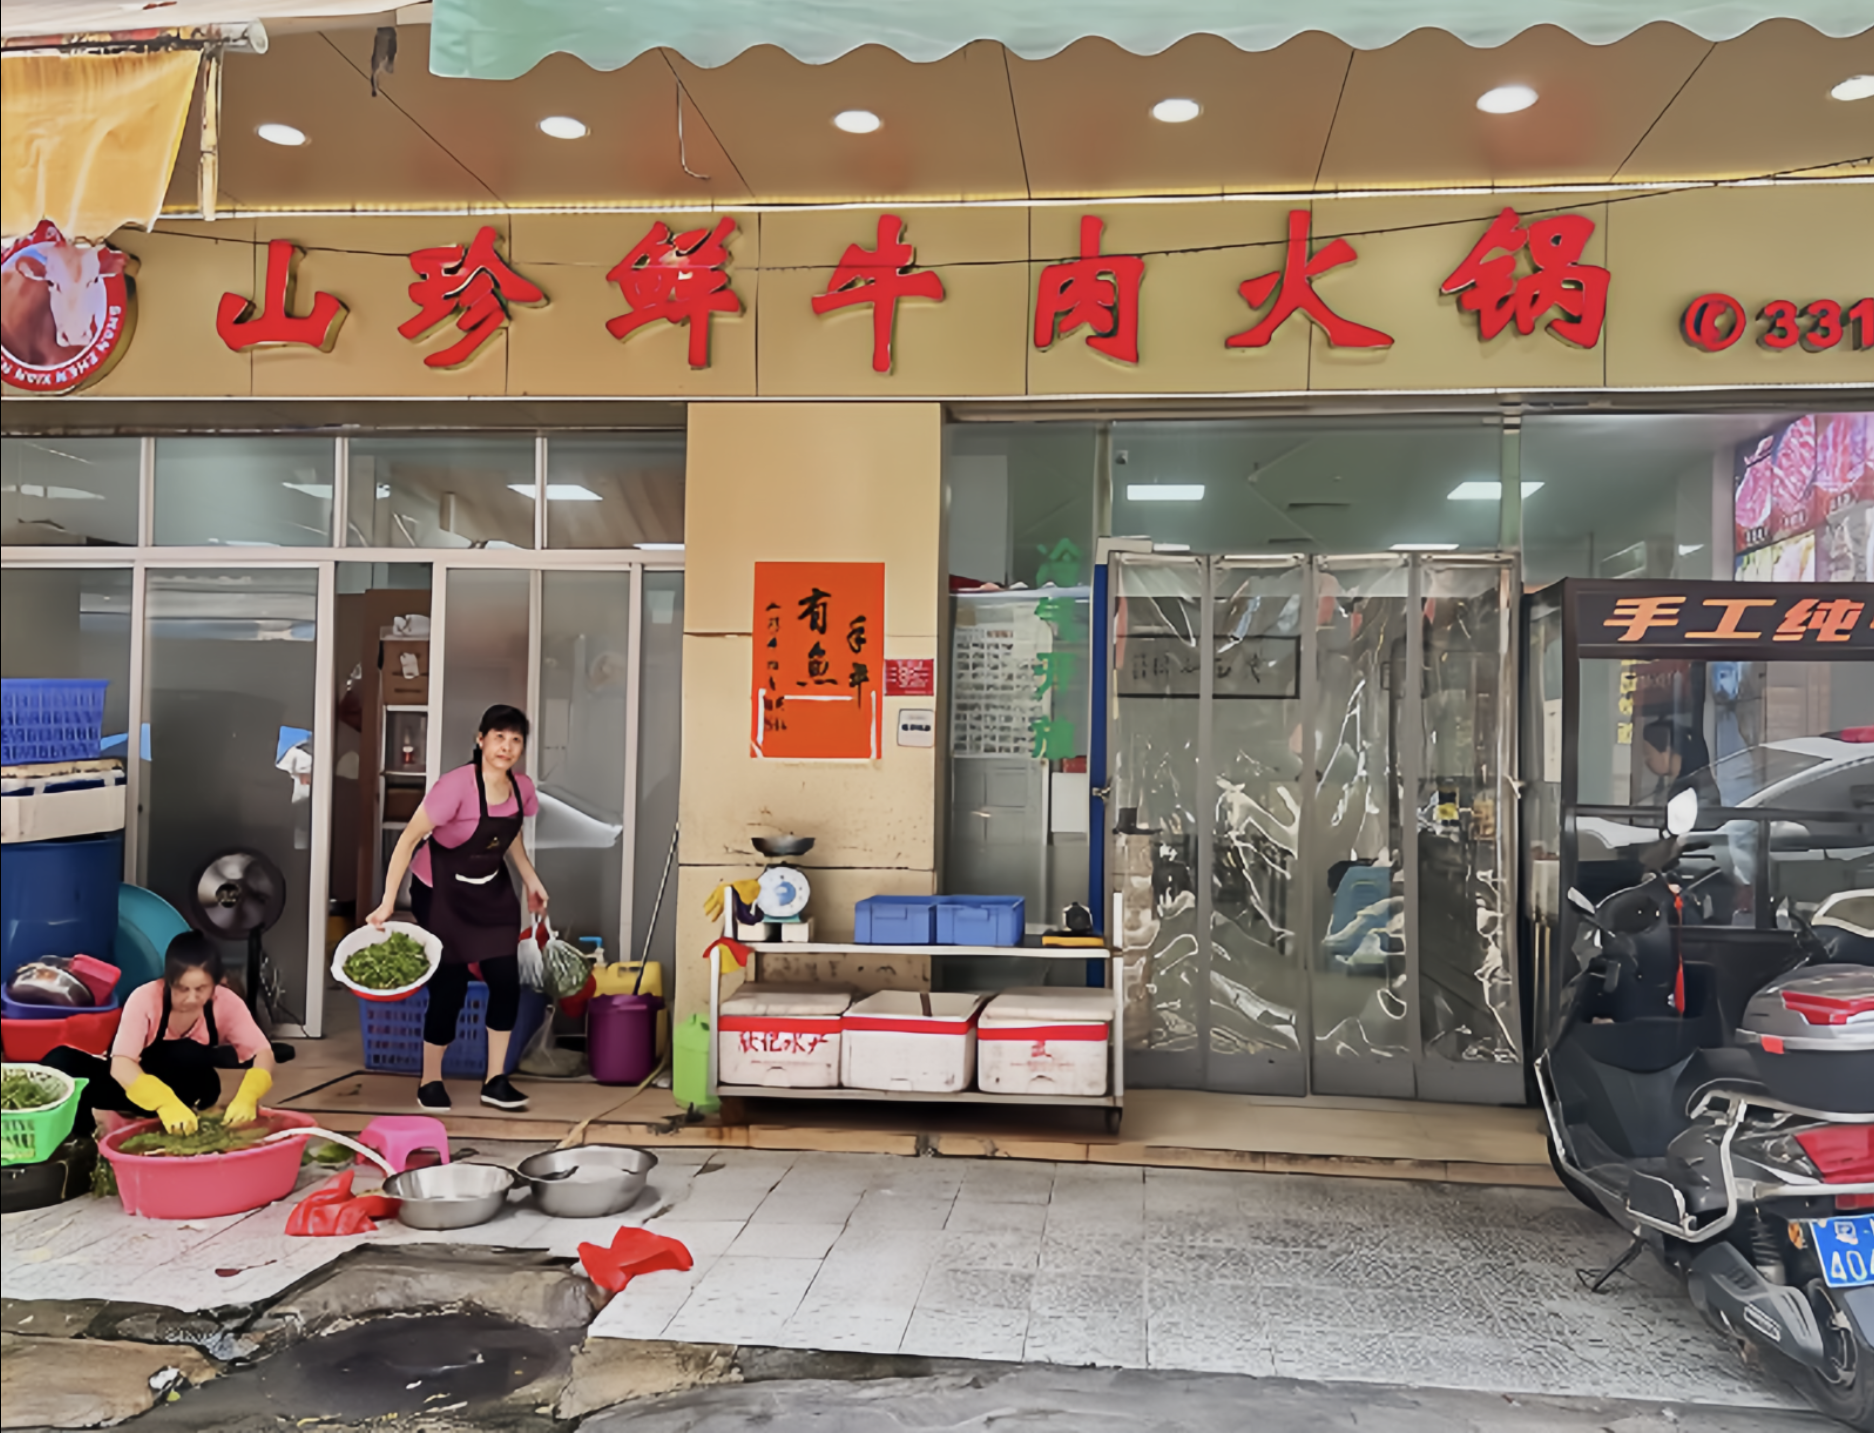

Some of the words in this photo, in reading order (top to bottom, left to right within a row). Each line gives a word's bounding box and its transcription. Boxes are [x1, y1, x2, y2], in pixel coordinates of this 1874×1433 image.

[216, 206, 1611, 373] 山珍鲜牛肉火锅
[1602, 596, 1874, 641] 手工纯
[1831, 1249, 1874, 1281] 40
